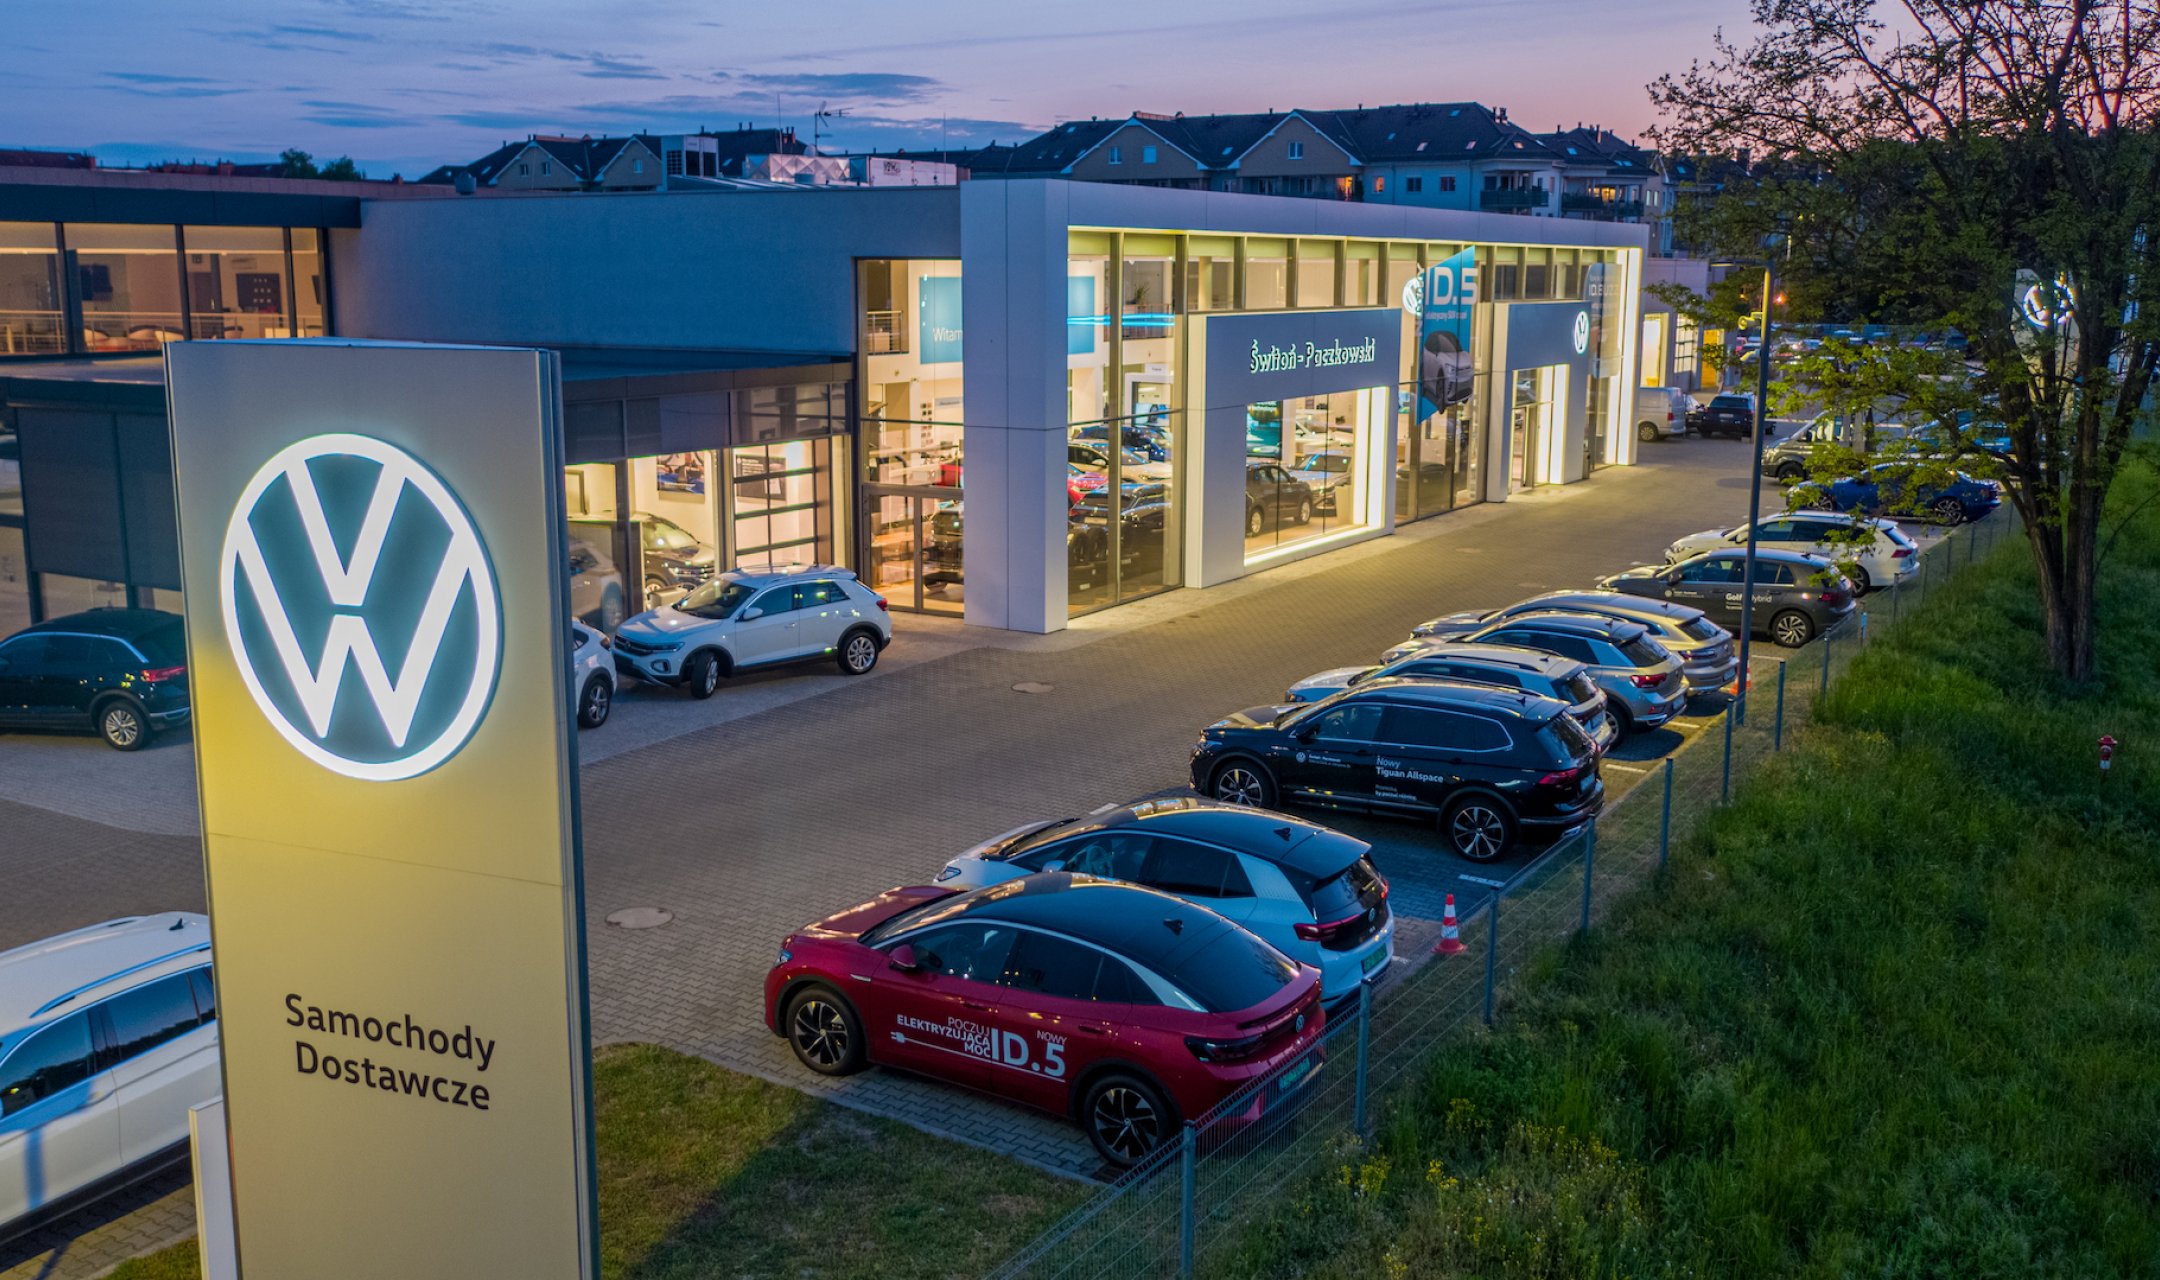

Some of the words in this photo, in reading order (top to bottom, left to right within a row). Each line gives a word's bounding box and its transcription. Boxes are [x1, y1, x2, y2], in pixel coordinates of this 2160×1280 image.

[1425, 266, 1478, 306] ID.5
[1375, 766, 1406, 778] Tiguan
[1406, 770, 1444, 783] Allspace
[285, 993, 495, 1072] Samochody
[947, 1016, 991, 1037] POCZUJ
[1036, 1029, 1068, 1046] NOWY
[964, 1042, 991, 1058] MOC
[991, 1027, 1067, 1077] ID.5
[296, 1040, 490, 1110] Dostawcze
